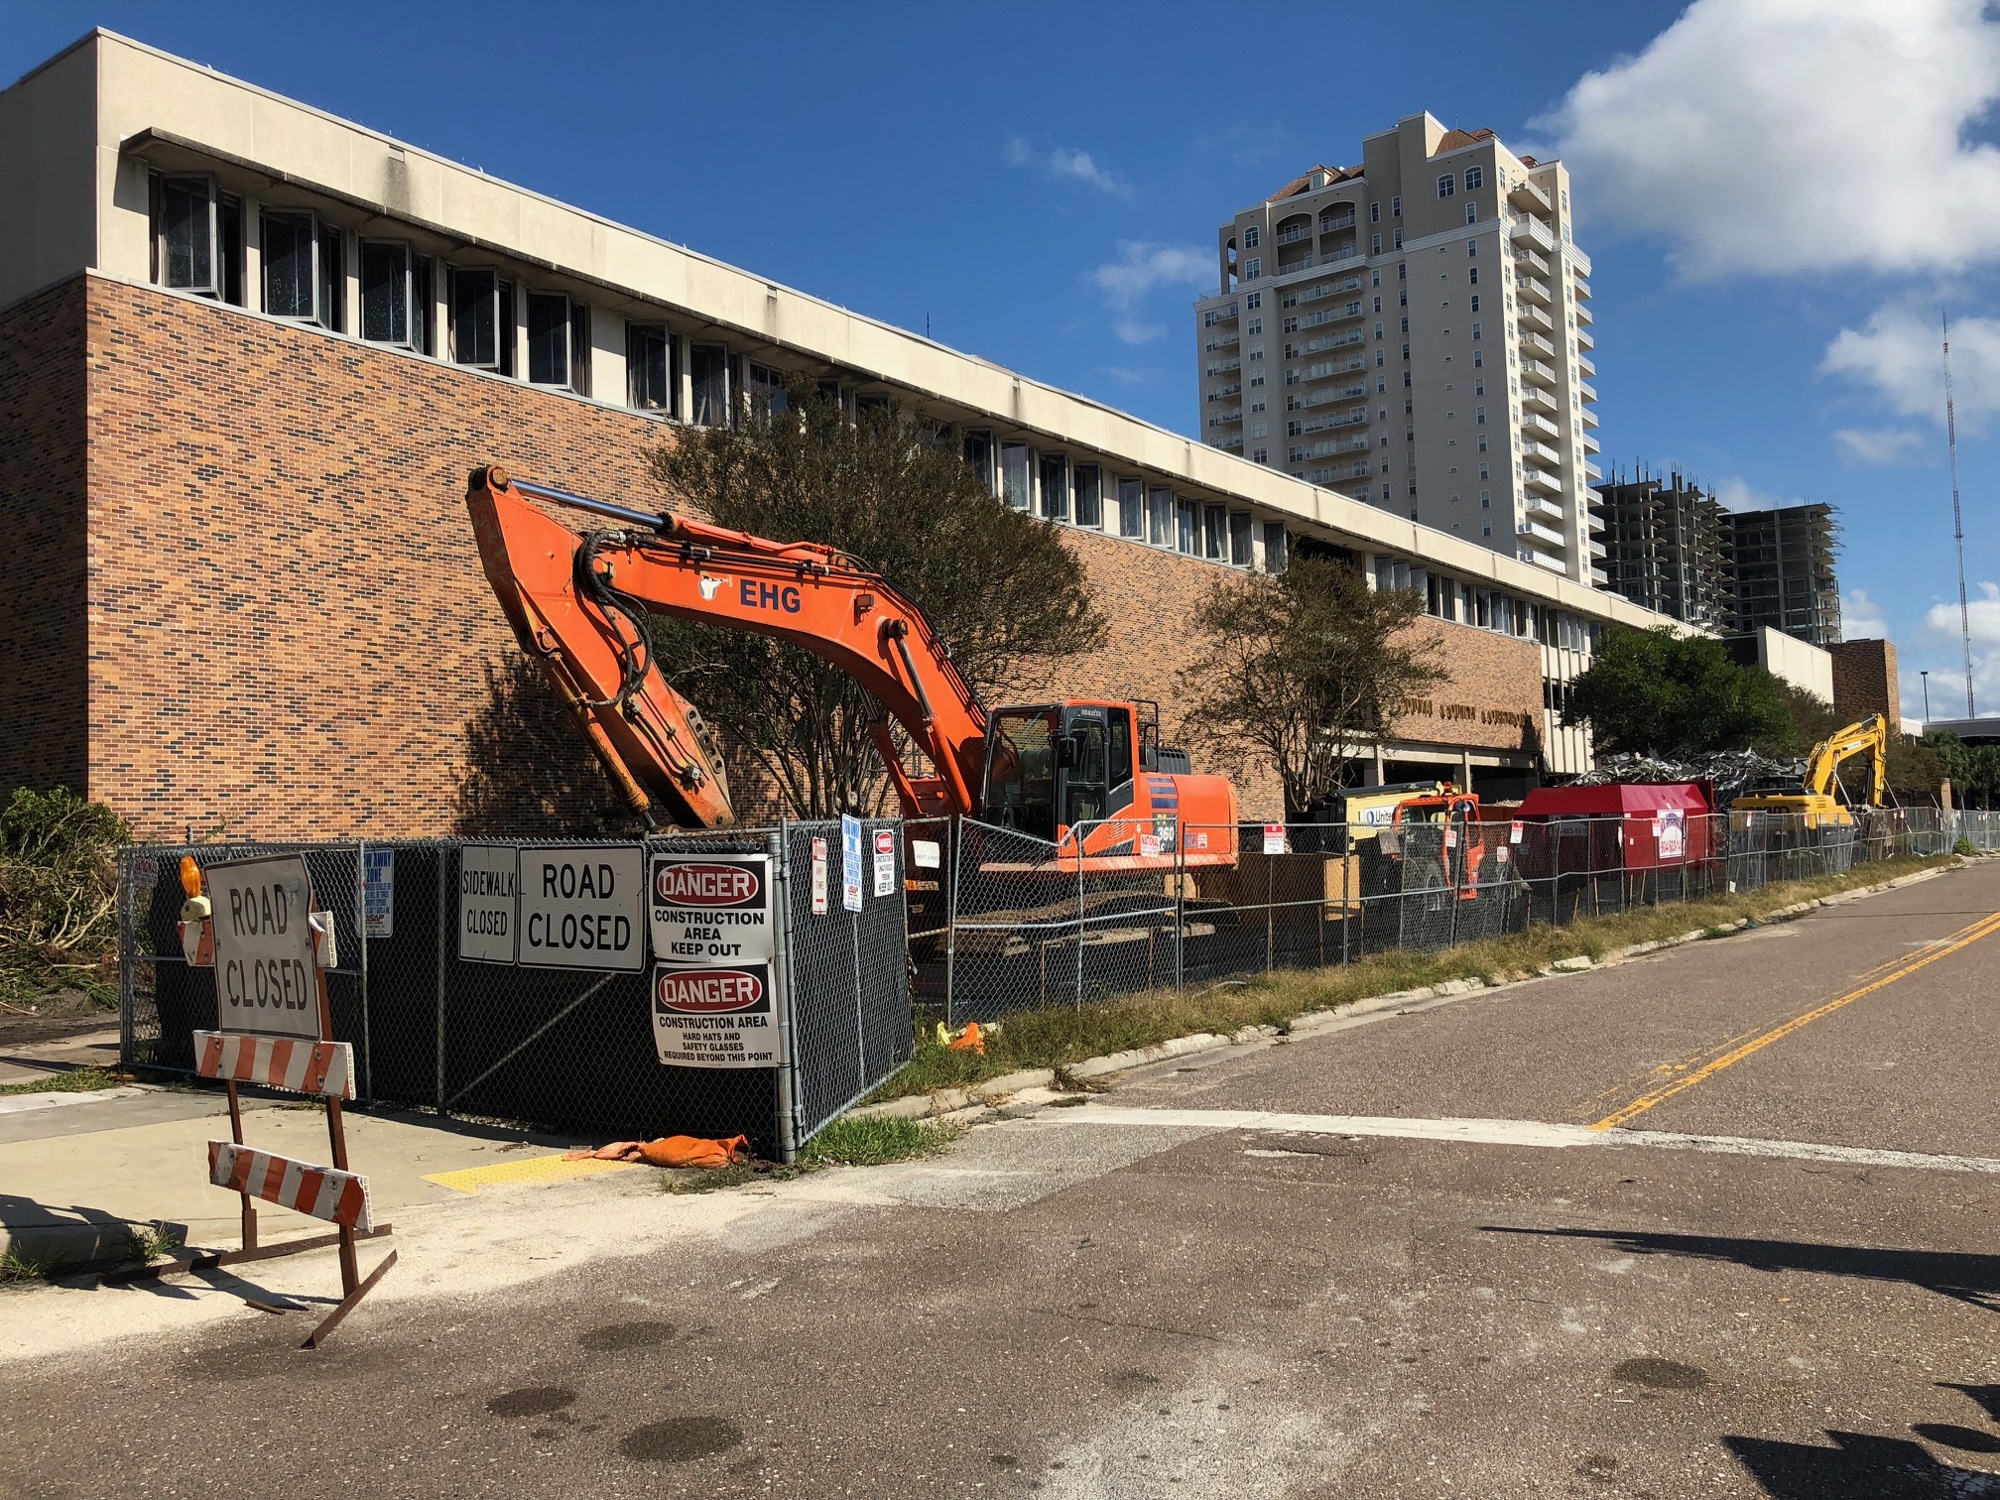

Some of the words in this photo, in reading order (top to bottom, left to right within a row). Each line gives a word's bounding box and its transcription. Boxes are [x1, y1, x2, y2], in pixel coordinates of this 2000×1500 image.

[740, 579, 800, 613] EHG
[1375, 809, 1392, 823] Unite
[1158, 826, 1175, 841] 360
[366, 868, 381, 883] ZONE
[462, 870, 515, 898] SIDEWALK
[543, 863, 615, 899] ROAD
[662, 872, 750, 898] DANGER
[229, 883, 288, 937] ROAD
[655, 909, 765, 926] CONSTRUCTION
[466, 909, 508, 937] CLOSED
[528, 912, 631, 951] CLOSED
[683, 927, 722, 941] AREA
[671, 942, 704, 956] KEEP
[707, 943, 742, 957] OUT
[226, 958, 308, 1011] CLOSED
[663, 977, 755, 1004] DANGER
[659, 1015, 735, 1030] CONSTRUCTION
[737, 1015, 769, 1028] AREA
[682, 1032, 701, 1042] HARD
[702, 1032, 722, 1042] HATS
[723, 1032, 741, 1041] AND
[682, 1041, 708, 1052] SAFETY
[709, 1041, 745, 1052] GLASSES
[664, 1050, 696, 1062] REQUIRED
[696, 1051, 725, 1062] BEYOND
[727, 1051, 746, 1062] THIS
[747, 1051, 774, 1061] POINT
